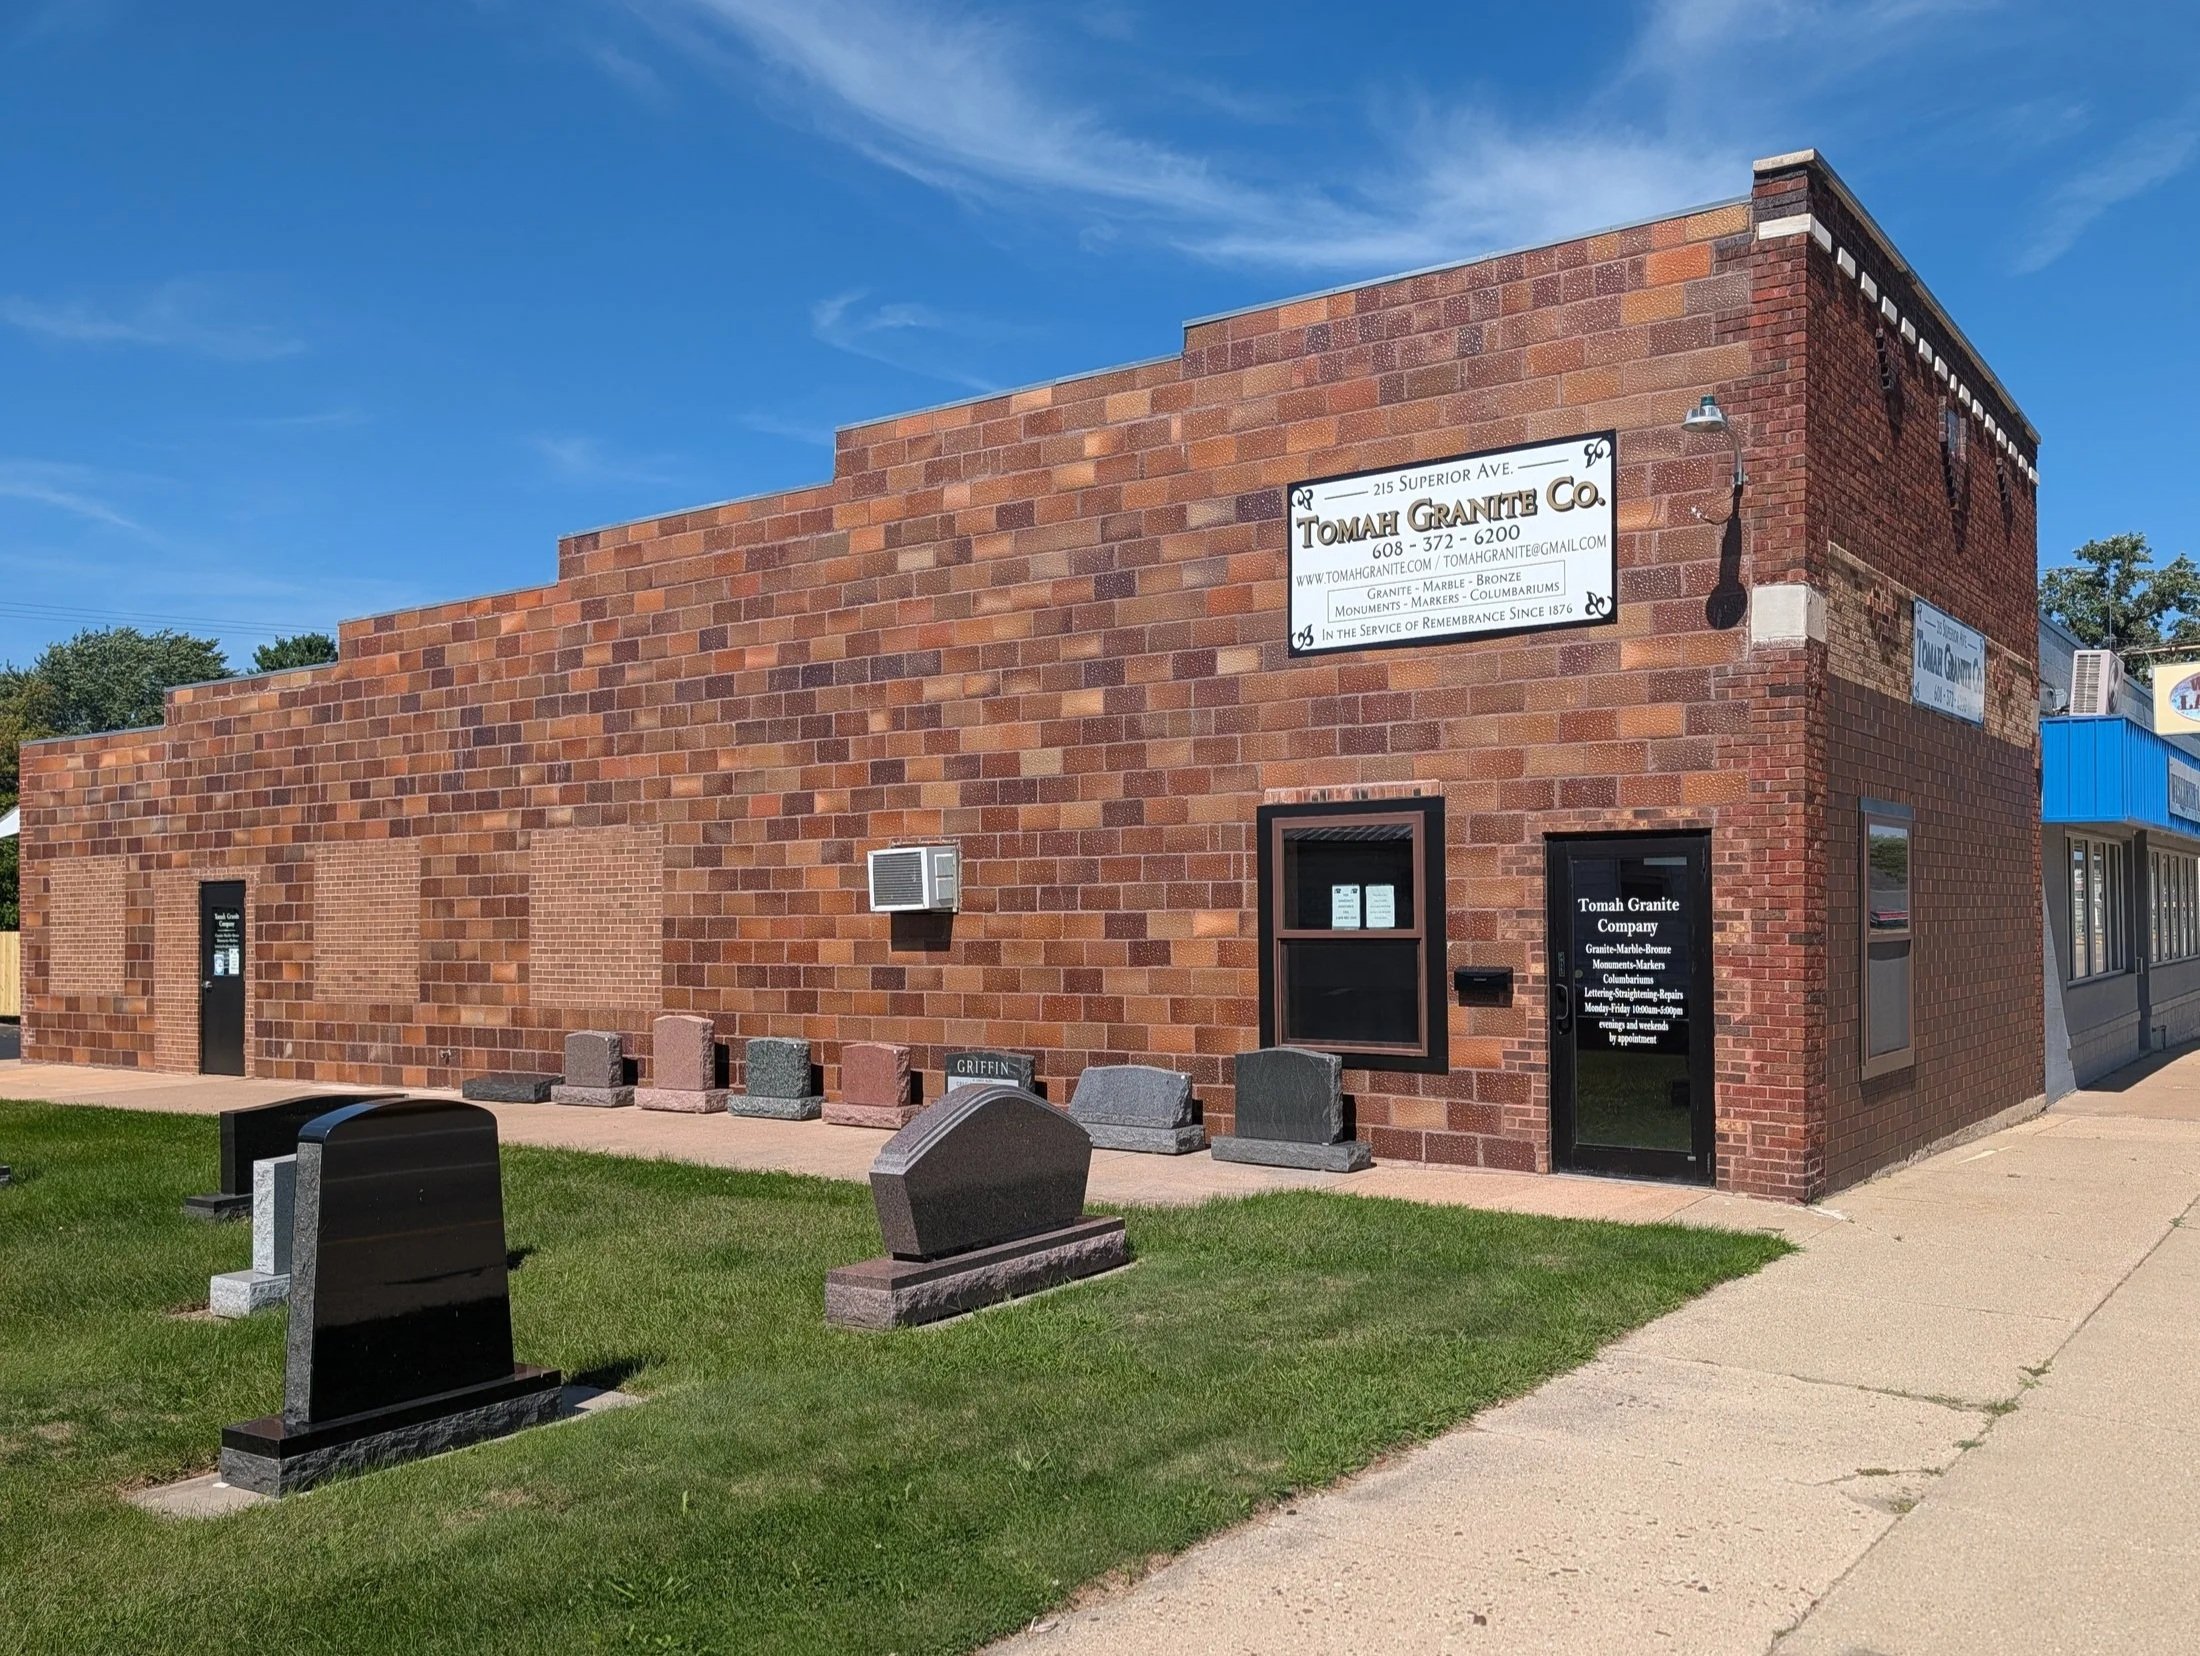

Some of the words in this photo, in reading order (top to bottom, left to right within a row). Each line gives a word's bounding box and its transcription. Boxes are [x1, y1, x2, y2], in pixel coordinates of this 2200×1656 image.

[1373, 481, 1394, 496] 215
[1399, 469, 1471, 492] SUPERIOR
[1477, 462, 1513, 480] AVE.
[1296, 510, 1400, 549] TOMAH
[1407, 487, 1538, 532] GRANITE
[1546, 475, 1606, 513] CO.
[1372, 540, 1404, 559] 608
[1423, 534, 1453, 552] 372
[1474, 524, 1520, 545] 6200
[1296, 558, 1432, 587] WWW.TOMAHGRANITE.COM
[1443, 534, 1607, 568] TOMAHGRANITE@GMAIL.COM
[1367, 585, 1412, 600] GRANITE
[1422, 579, 1465, 593] MARBLE
[1476, 571, 1522, 587] BRONZE
[1335, 601, 1401, 618] MONUMENTS
[1411, 593, 1460, 608] MARKERS
[1470, 581, 1560, 602] COLUMBARIUMS
[1322, 628, 1334, 641] IN
[1336, 627, 1357, 639] THE
[1360, 623, 1401, 637] SERVICE
[1405, 620, 1419, 632] OF
[1422, 610, 1506, 630] REMEMBRANCE
[1509, 606, 1545, 620] SINCE
[1549, 603, 1573, 616] 1876
[1916, 627, 1944, 678] TOMAH
[1577, 897, 1624, 912] Tomah
[1627, 896, 1680, 912] Granite
[1597, 918, 1659, 937] Company
[1585, 943, 1672, 955] Granite-Marble-Bronze
[1592, 958, 1666, 970] Monuments-Markers
[1603, 973, 1654, 985] Columbariums
[1584, 987, 1684, 1003] Lettering-Straightening-Repairs
[1584, 1002, 1631, 1017] Monday-Friday
[1632, 1004, 1684, 1019] 10:00am-5:00pm
[1599, 1018, 1625, 1032] evenings
[1626, 1019, 1638, 1030] and
[1639, 1020, 1669, 1031] weekends
[1608, 1031, 1617, 1046] by
[1617, 1033, 1657, 1046] appointment
[957, 1059, 1009, 1076] GRIFFIN
